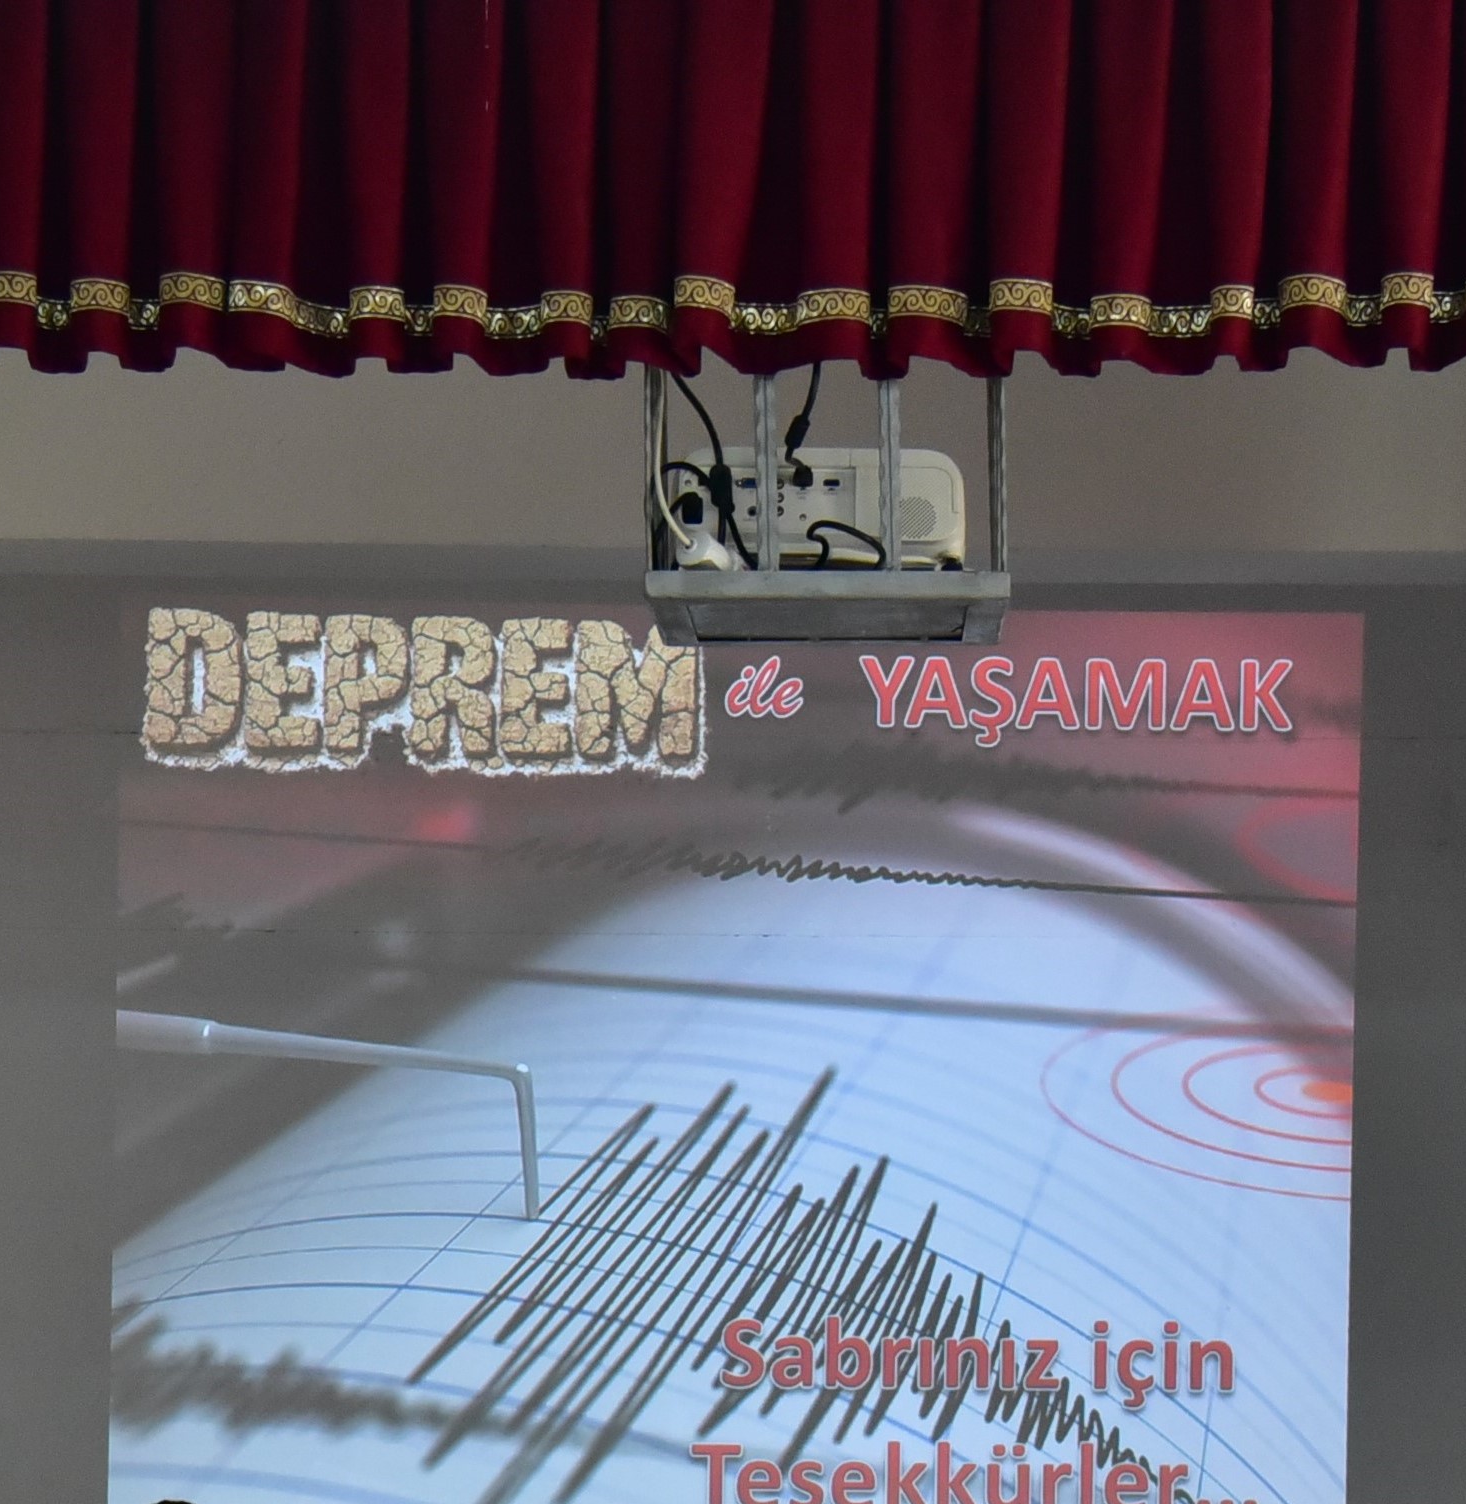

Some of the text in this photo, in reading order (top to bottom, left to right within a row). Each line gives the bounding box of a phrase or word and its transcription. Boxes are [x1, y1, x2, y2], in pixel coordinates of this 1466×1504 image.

[139, 606, 1295, 778] DEPREM ile YAŞAMAK
[718, 1314, 1236, 1408] Sabrınız için
